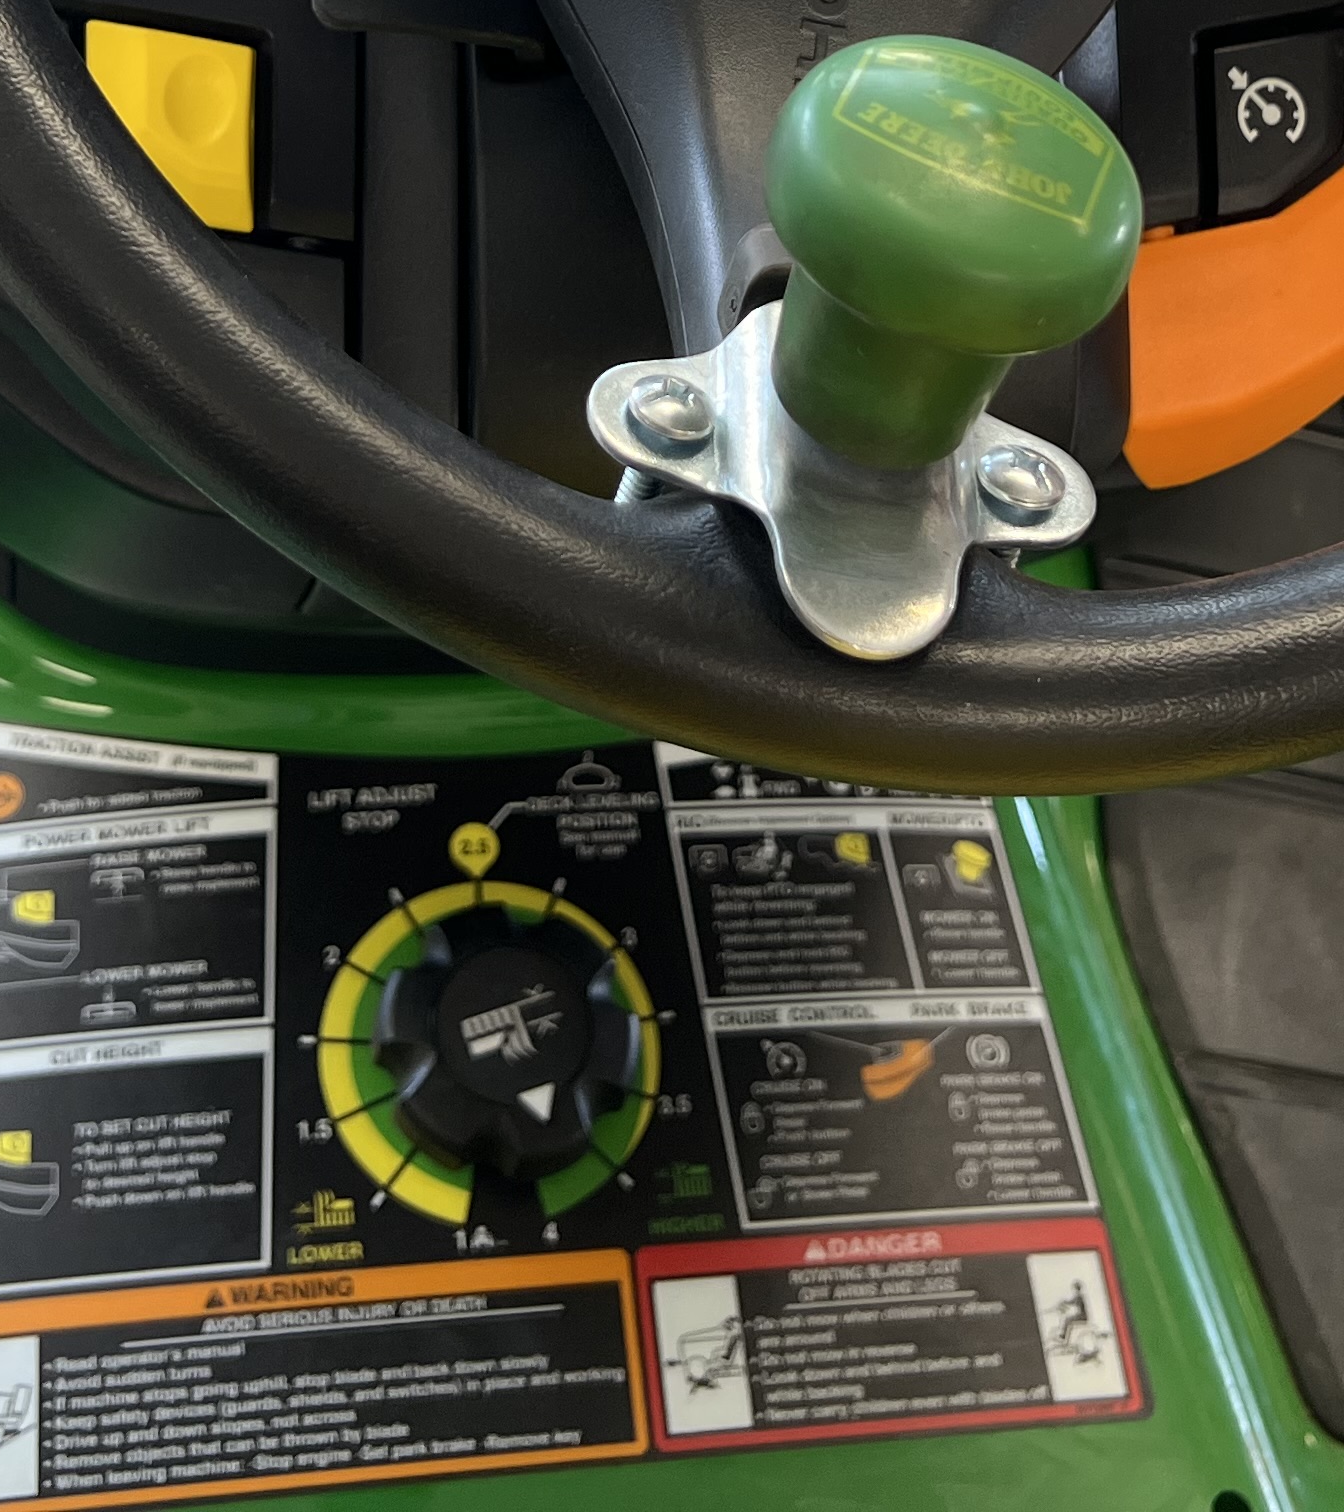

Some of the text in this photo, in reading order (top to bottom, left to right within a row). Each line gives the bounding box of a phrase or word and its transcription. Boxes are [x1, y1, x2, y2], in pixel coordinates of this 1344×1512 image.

[857, 102, 1073, 205] JOHN DEERE
[307, 783, 438, 812] LIFT ADJUST
[25, 814, 210, 849] POWER MOWER LIFT
[342, 809, 401, 835] STOP
[459, 837, 491, 855] 2.5
[322, 944, 341, 968] 2
[82, 960, 208, 985] LOWER MOWER
[712, 1004, 878, 1027] CRUISE CONTROL
[909, 1000, 1027, 1018] PARK BRAKE
[48, 1041, 162, 1066] CUT HEIGHT
[73, 1109, 232, 1138] TO SET CUT HEIGHT
[296, 1118, 334, 1145] 1.5
[287, 1241, 364, 1265] LOWER
[826, 1230, 943, 1258] DANGER
[230, 1275, 354, 1305] WARNING
